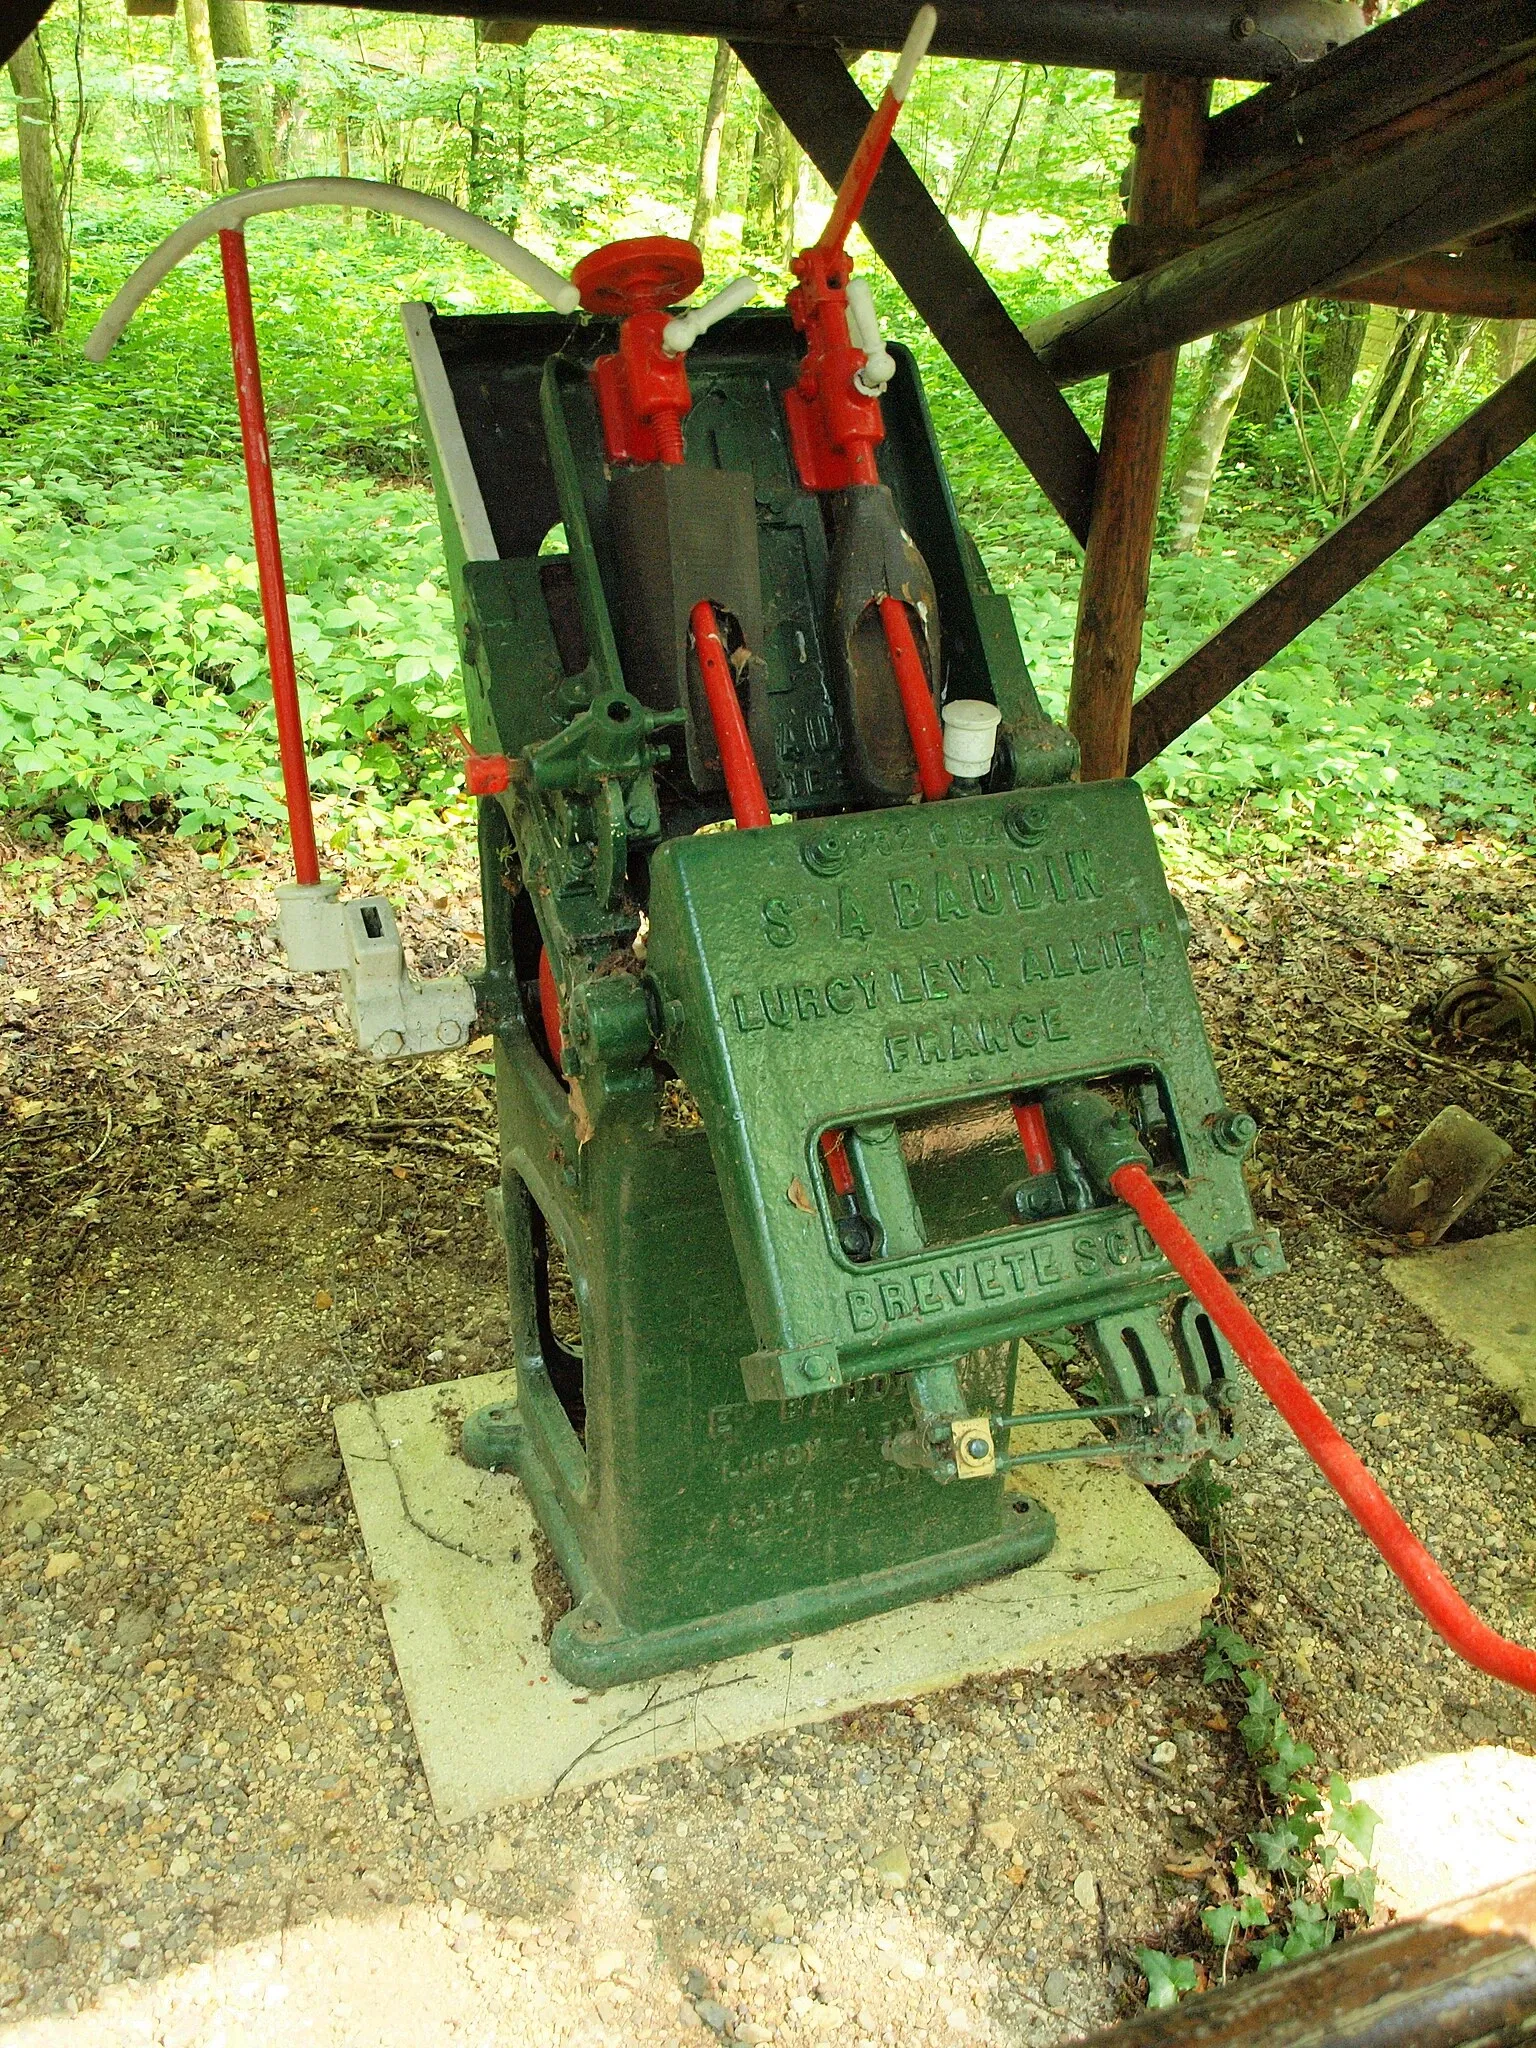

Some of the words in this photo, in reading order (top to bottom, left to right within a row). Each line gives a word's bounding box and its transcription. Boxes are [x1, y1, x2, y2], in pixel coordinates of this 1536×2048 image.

[838, 886, 875, 941] A
[888, 848, 1105, 931] BAUDIN
[731, 973, 879, 1034] LURCY
[889, 953, 1002, 1004] LEVY
[1020, 922, 1168, 985] ALLIER
[884, 1006, 1071, 1074] FRANCE
[846, 1243, 1062, 1334] BREVETE
